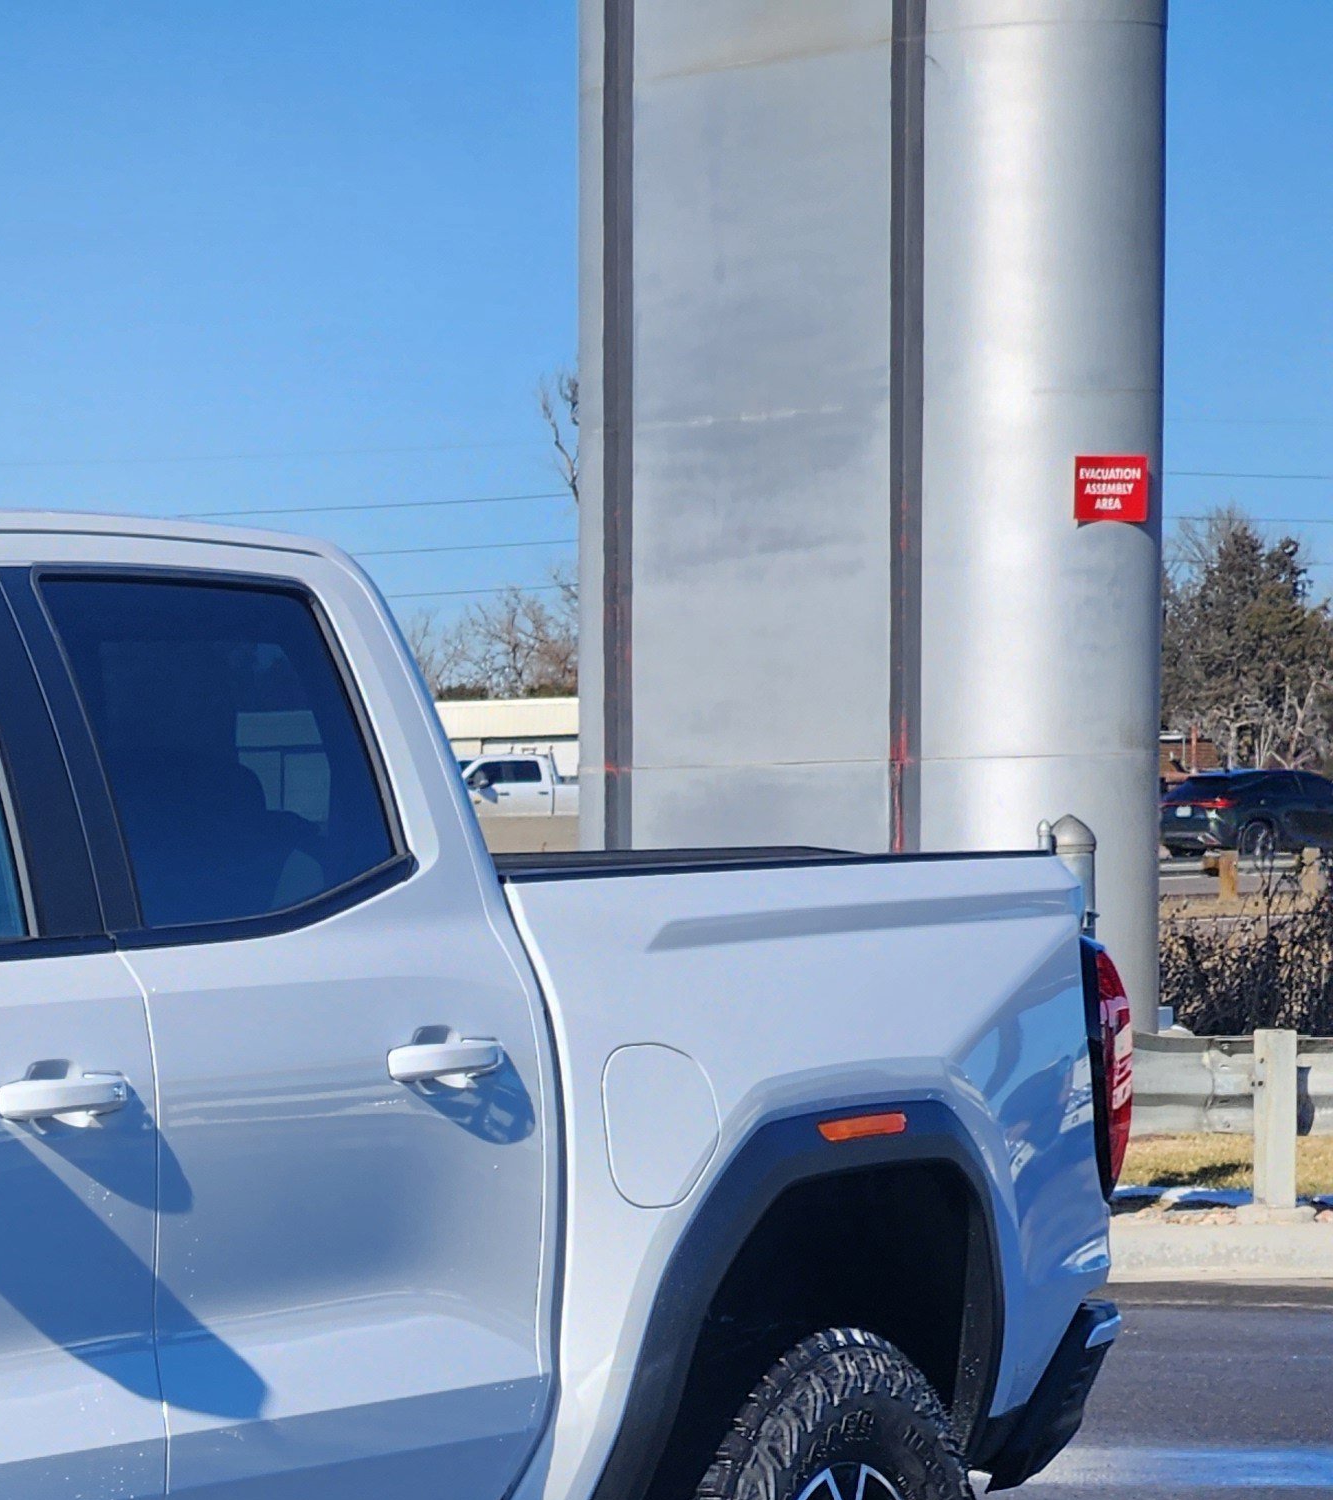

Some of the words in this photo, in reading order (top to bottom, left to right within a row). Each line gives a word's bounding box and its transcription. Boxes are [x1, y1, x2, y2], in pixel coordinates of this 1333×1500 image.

[1079, 467, 1141, 480] EVACUATION
[1084, 483, 1134, 495] ASSEMBLY
[1094, 497, 1122, 510] AREA
